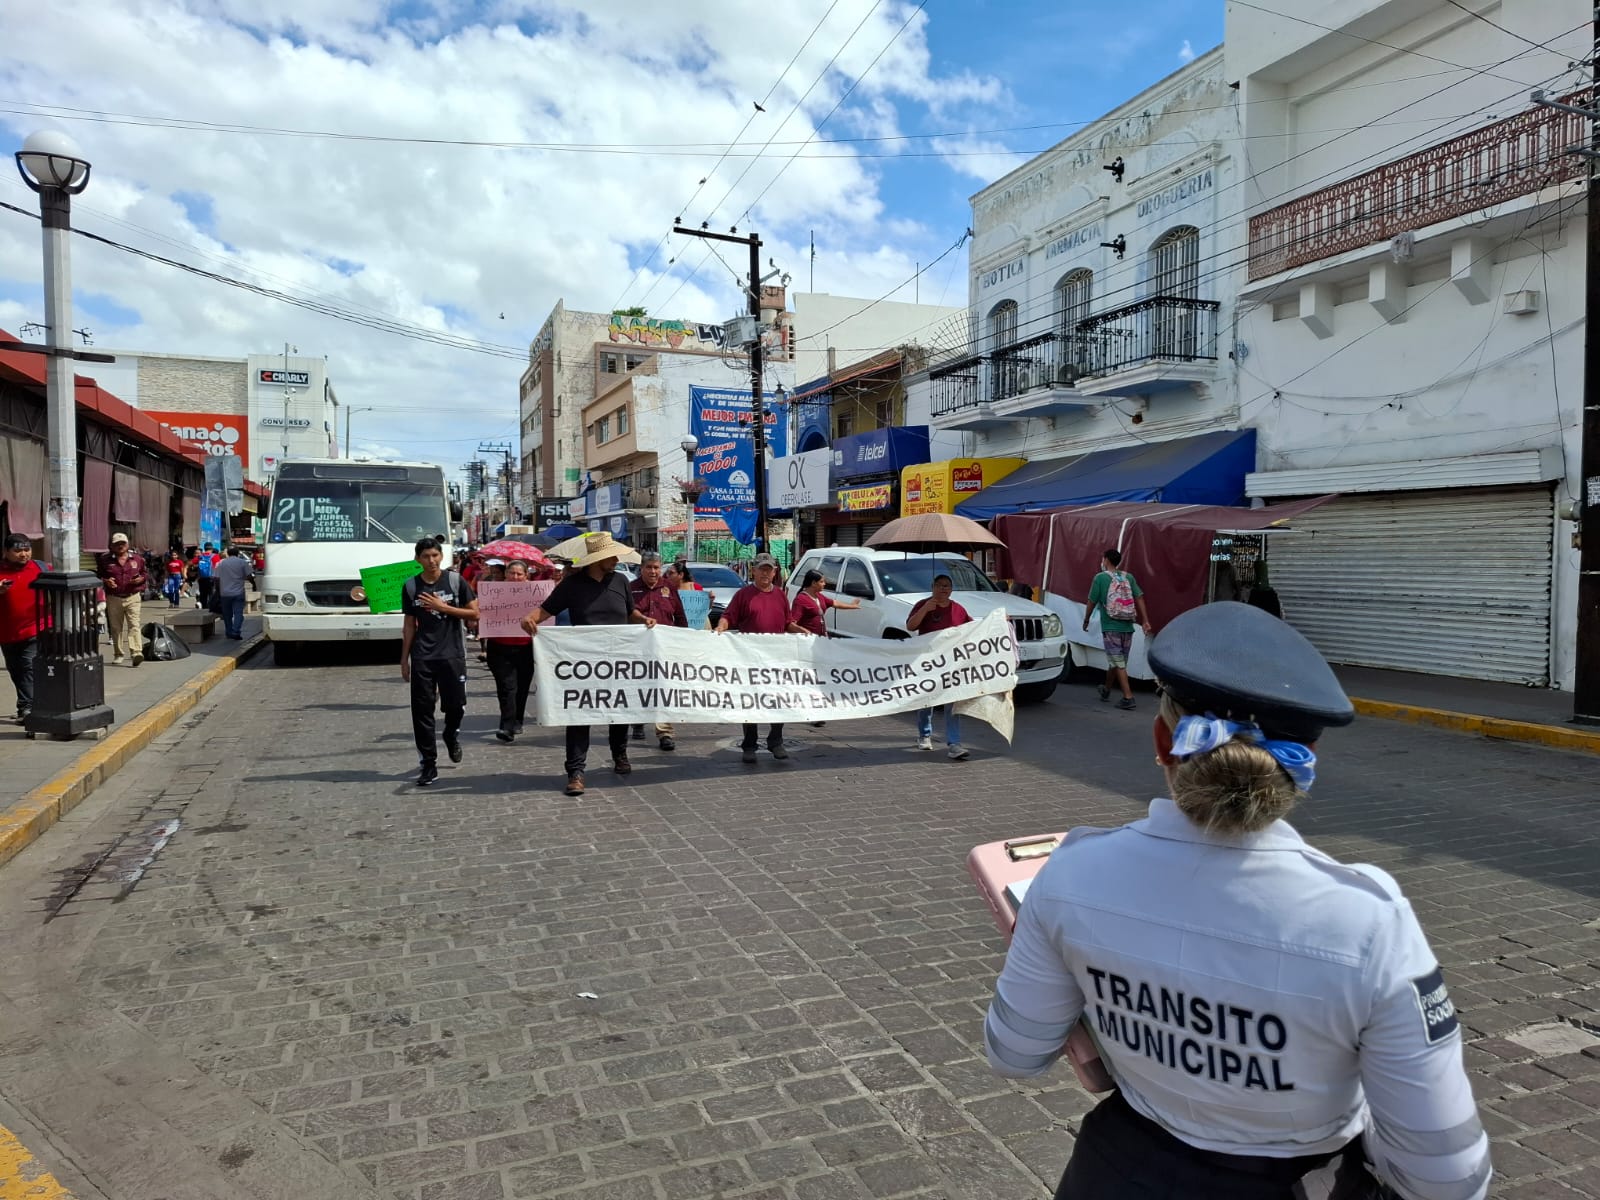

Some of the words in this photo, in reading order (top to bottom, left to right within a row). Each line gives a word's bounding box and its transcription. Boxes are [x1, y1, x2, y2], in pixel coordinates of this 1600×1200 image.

[983, 258, 1024, 289] BOTICA
[272, 372, 308, 383] CHARLY
[262, 418, 303, 426] CONVRSE
[701, 409, 735, 422] MEJOR
[865, 441, 887, 460] telcel
[699, 456, 738, 475] TODO!
[277, 497, 315, 524] 20
[554, 660, 742, 685] COORDINADORA
[749, 667, 826, 686] ESTATAL
[830, 663, 917, 684] SOLICITA
[920, 654, 946, 672] SU
[952, 635, 1012, 662] APOYO
[563, 688, 629, 709] PARA
[637, 687, 735, 709] VIVIENDA
[739, 692, 806, 710] DIGNA
[810, 694, 837, 709] EN
[840, 678, 937, 707] NUESTRO
[941, 660, 1014, 689] ESTADO.
[1086, 966, 1287, 1051] TRANSITO
[1095, 1004, 1295, 1091] MUNICIPAL
